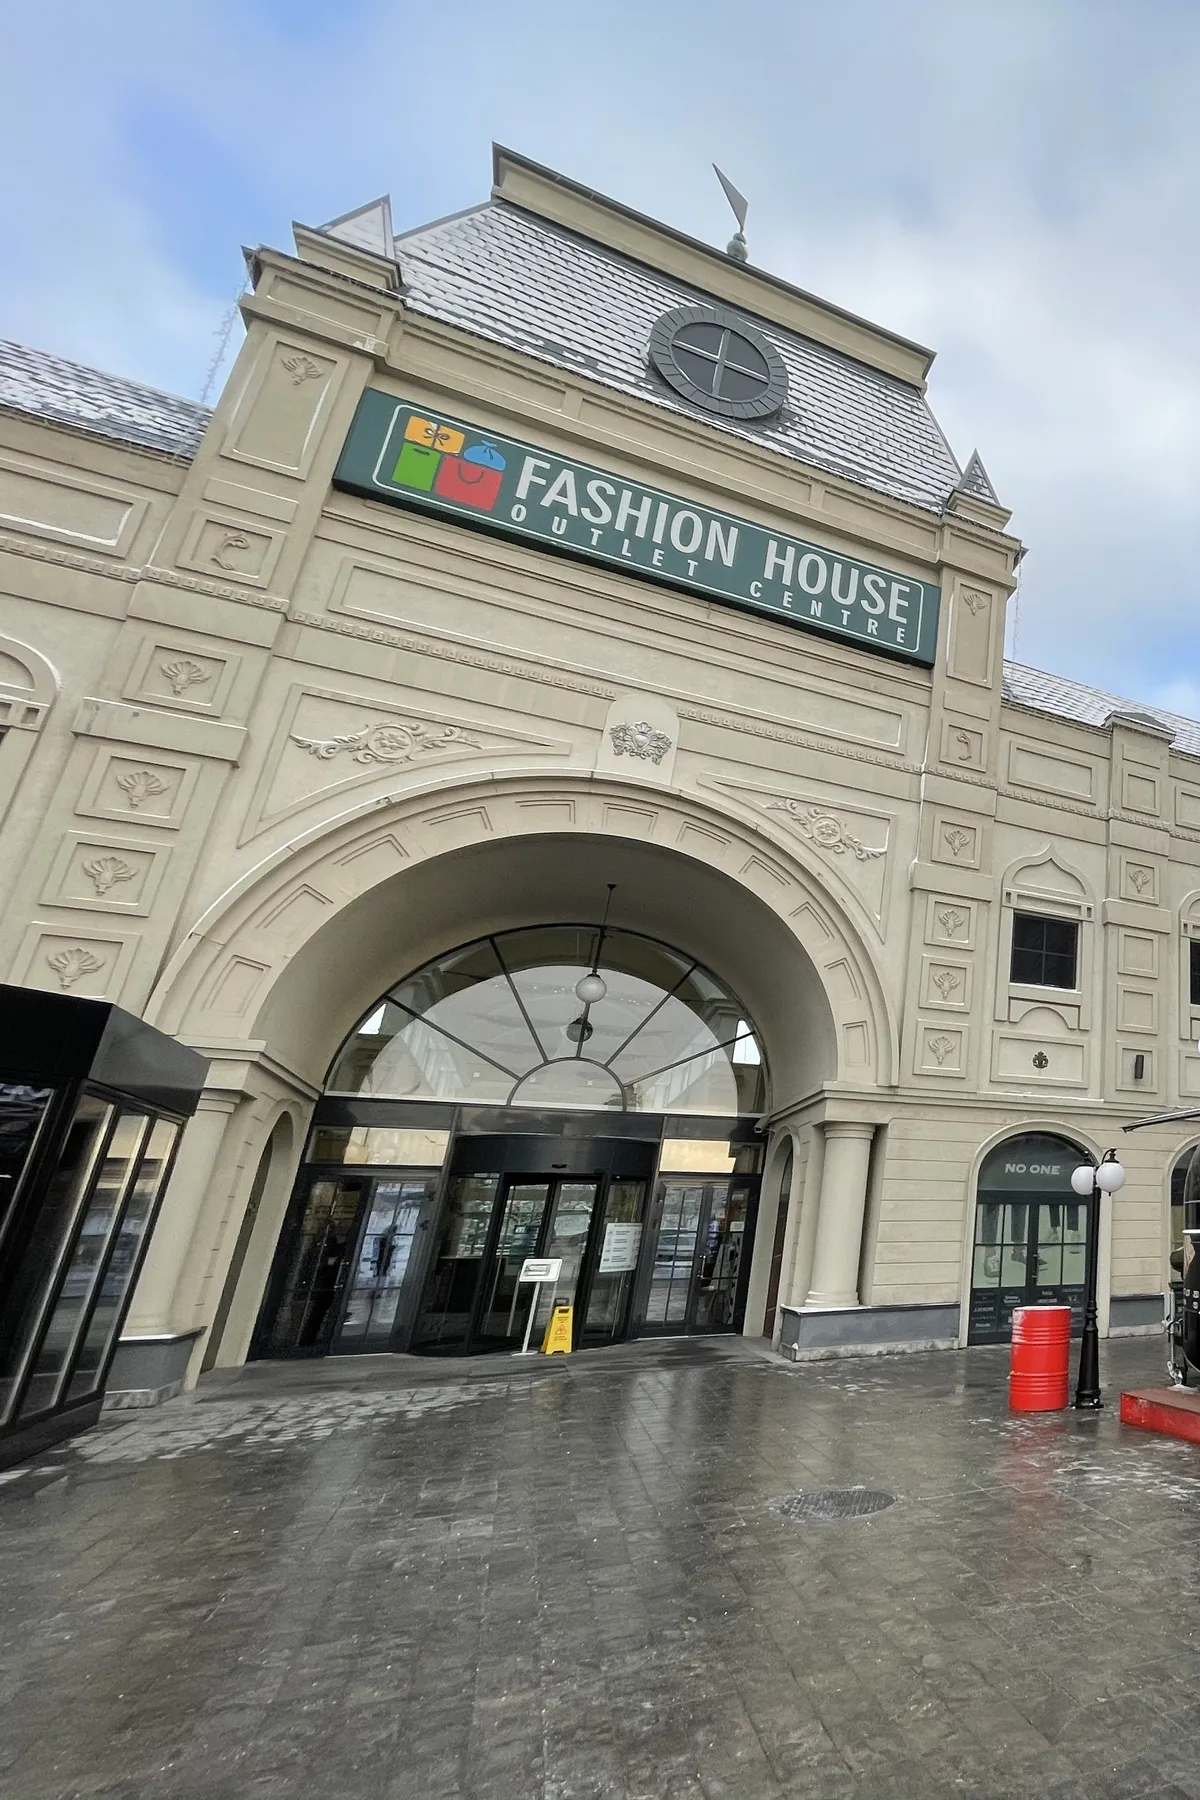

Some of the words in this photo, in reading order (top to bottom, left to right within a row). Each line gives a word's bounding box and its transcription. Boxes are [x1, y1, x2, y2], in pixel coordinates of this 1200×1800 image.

[511, 503, 701, 577] OUTLET
[750, 580, 907, 645] CENTRE
[515, 455, 740, 569] FASHION
[763, 538, 912, 626] HOUSE
[1004, 1163, 1027, 1174] NO
[1029, 1164, 1061, 1175] ONE
